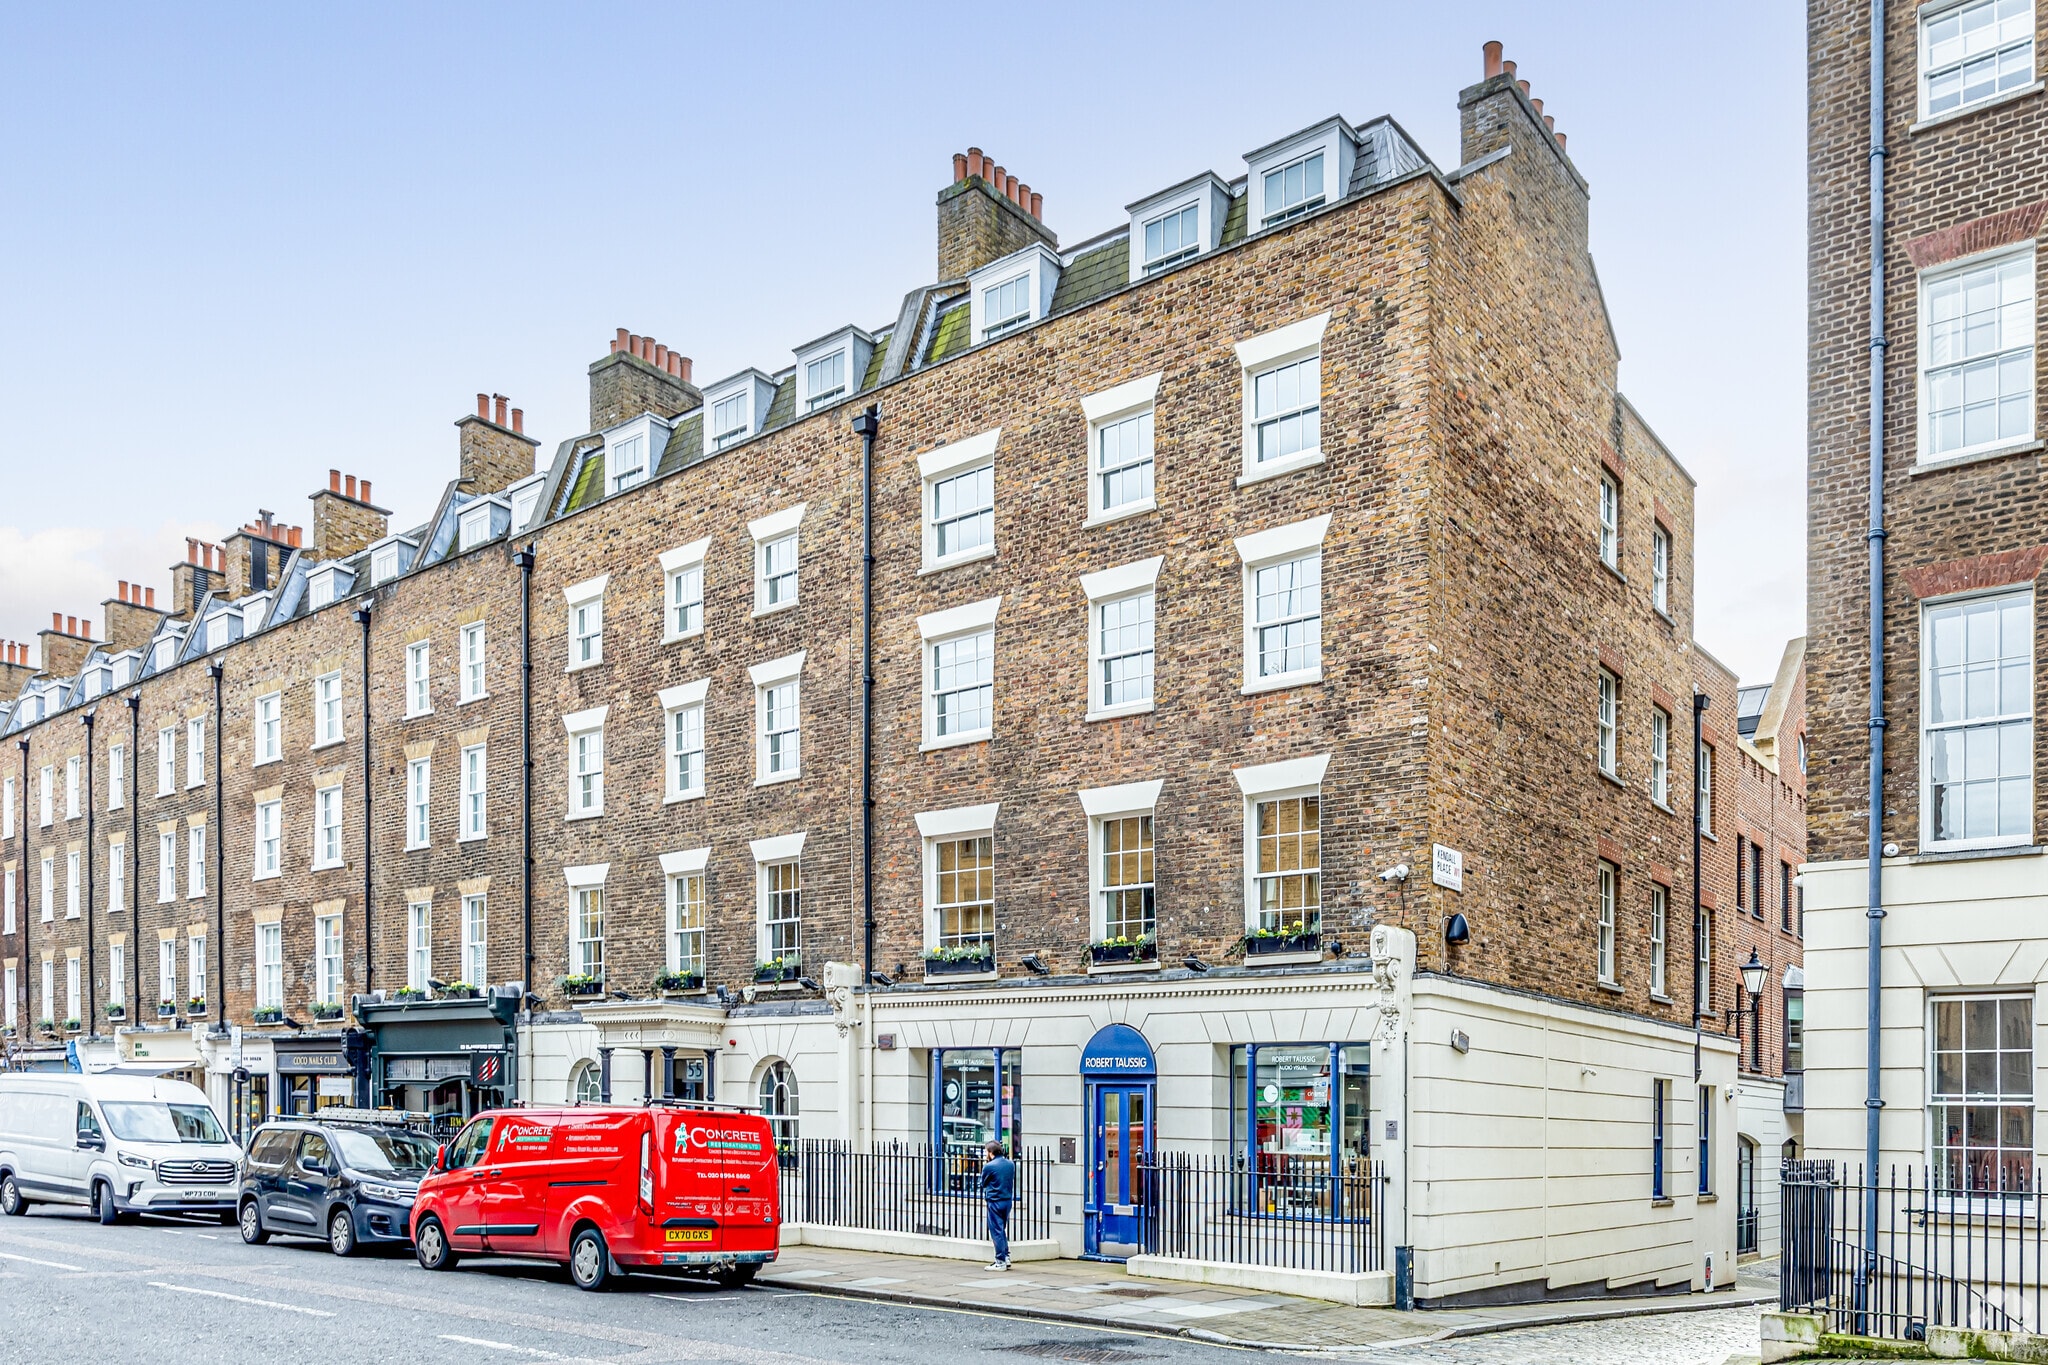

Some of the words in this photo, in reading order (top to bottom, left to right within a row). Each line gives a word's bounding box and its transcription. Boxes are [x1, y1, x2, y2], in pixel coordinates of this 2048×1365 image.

[1437, 849, 1456, 864] KENDALL
[1437, 860, 1452, 875] PLACE
[293, 1056, 308, 1066] COCO
[308, 1056, 323, 1065] NAILS
[324, 1056, 337, 1065] CLUB
[1085, 1057, 1114, 1068] ROBERT
[1114, 1057, 1147, 1068] TAUSSIG
[688, 1062, 702, 1077] 55
[508, 1125, 552, 1143] CONCRETE
[690, 1127, 760, 1148] CONCRETE
[669, 1231, 691, 1239] CX70
[692, 1231, 709, 1239] GXS
